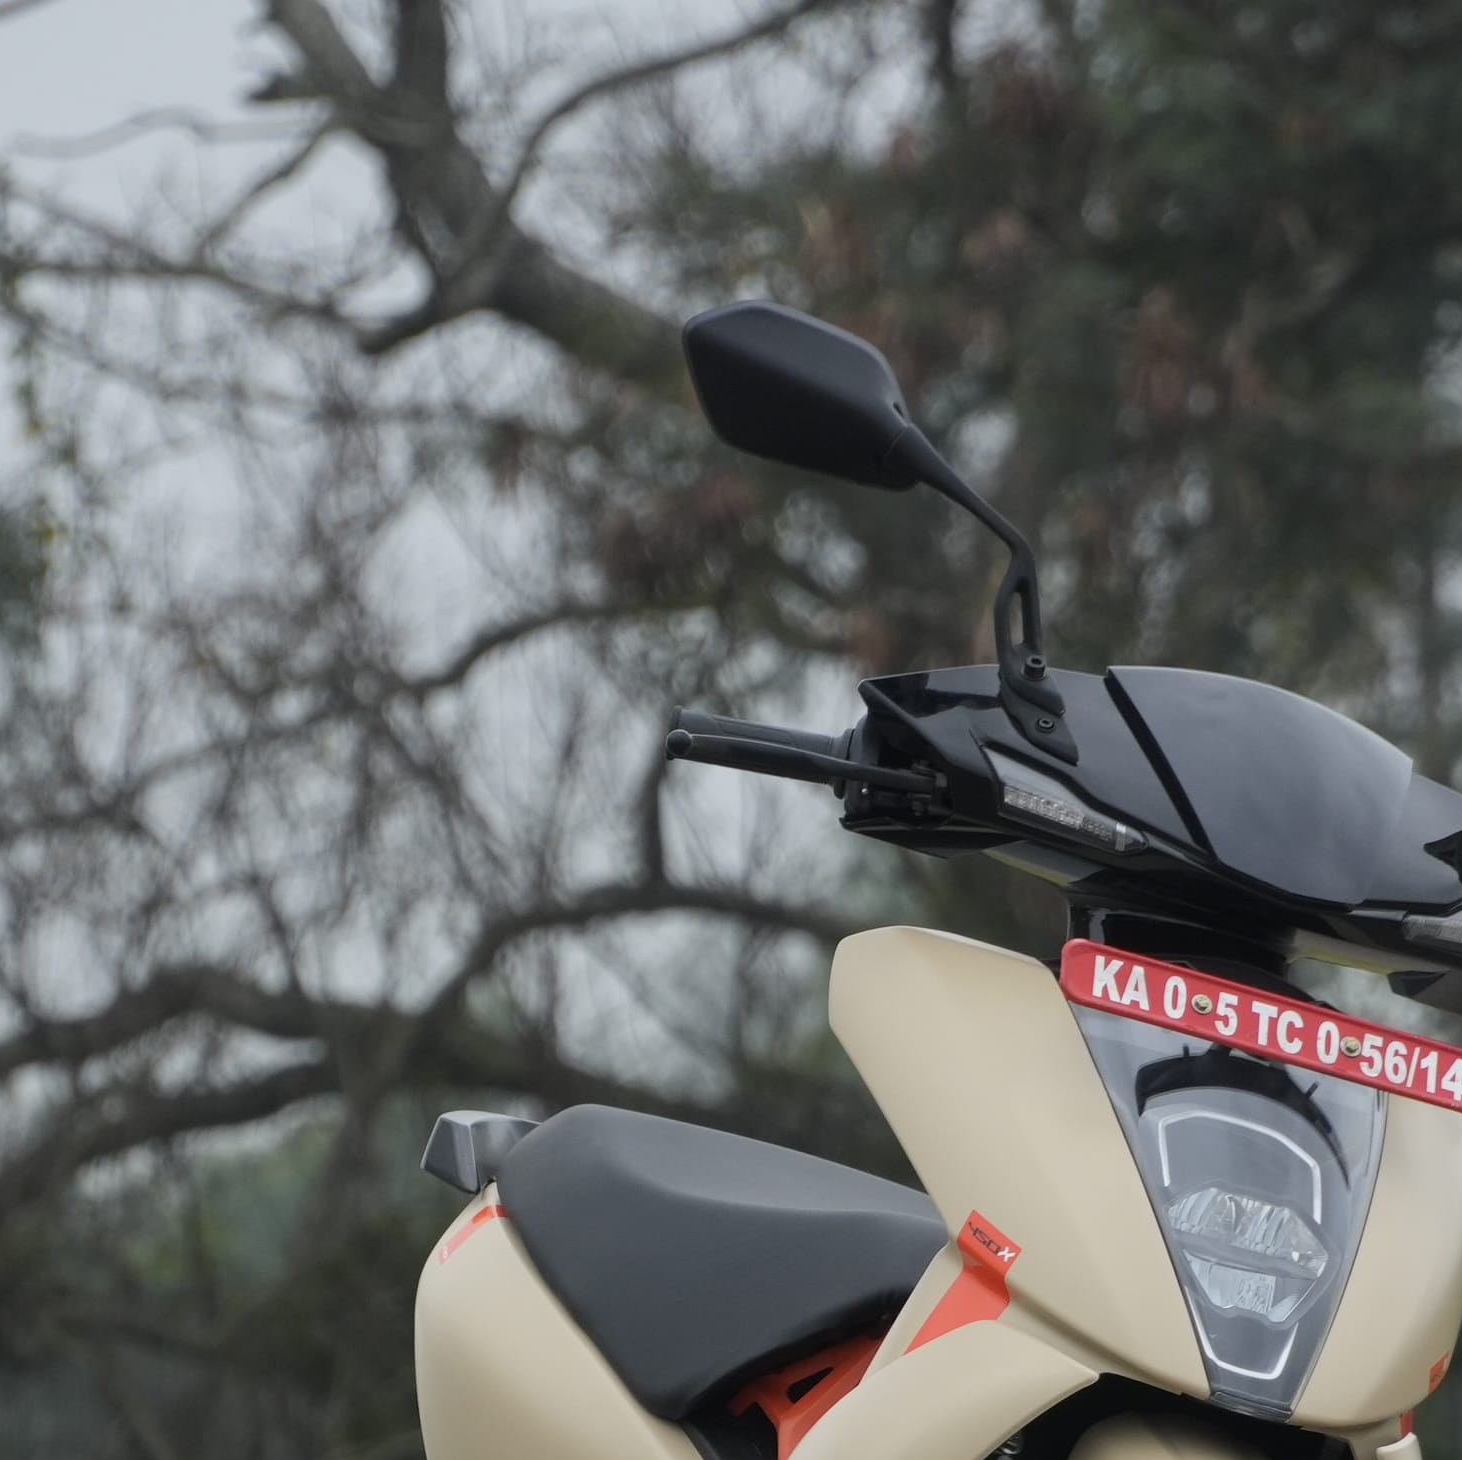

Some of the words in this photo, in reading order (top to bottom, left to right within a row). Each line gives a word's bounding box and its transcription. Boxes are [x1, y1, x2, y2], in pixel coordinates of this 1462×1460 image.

[1092, 955, 1150, 1011] KA
[1251, 1001, 1303, 1054] TC
[968, 1221, 1017, 1263] 450X
